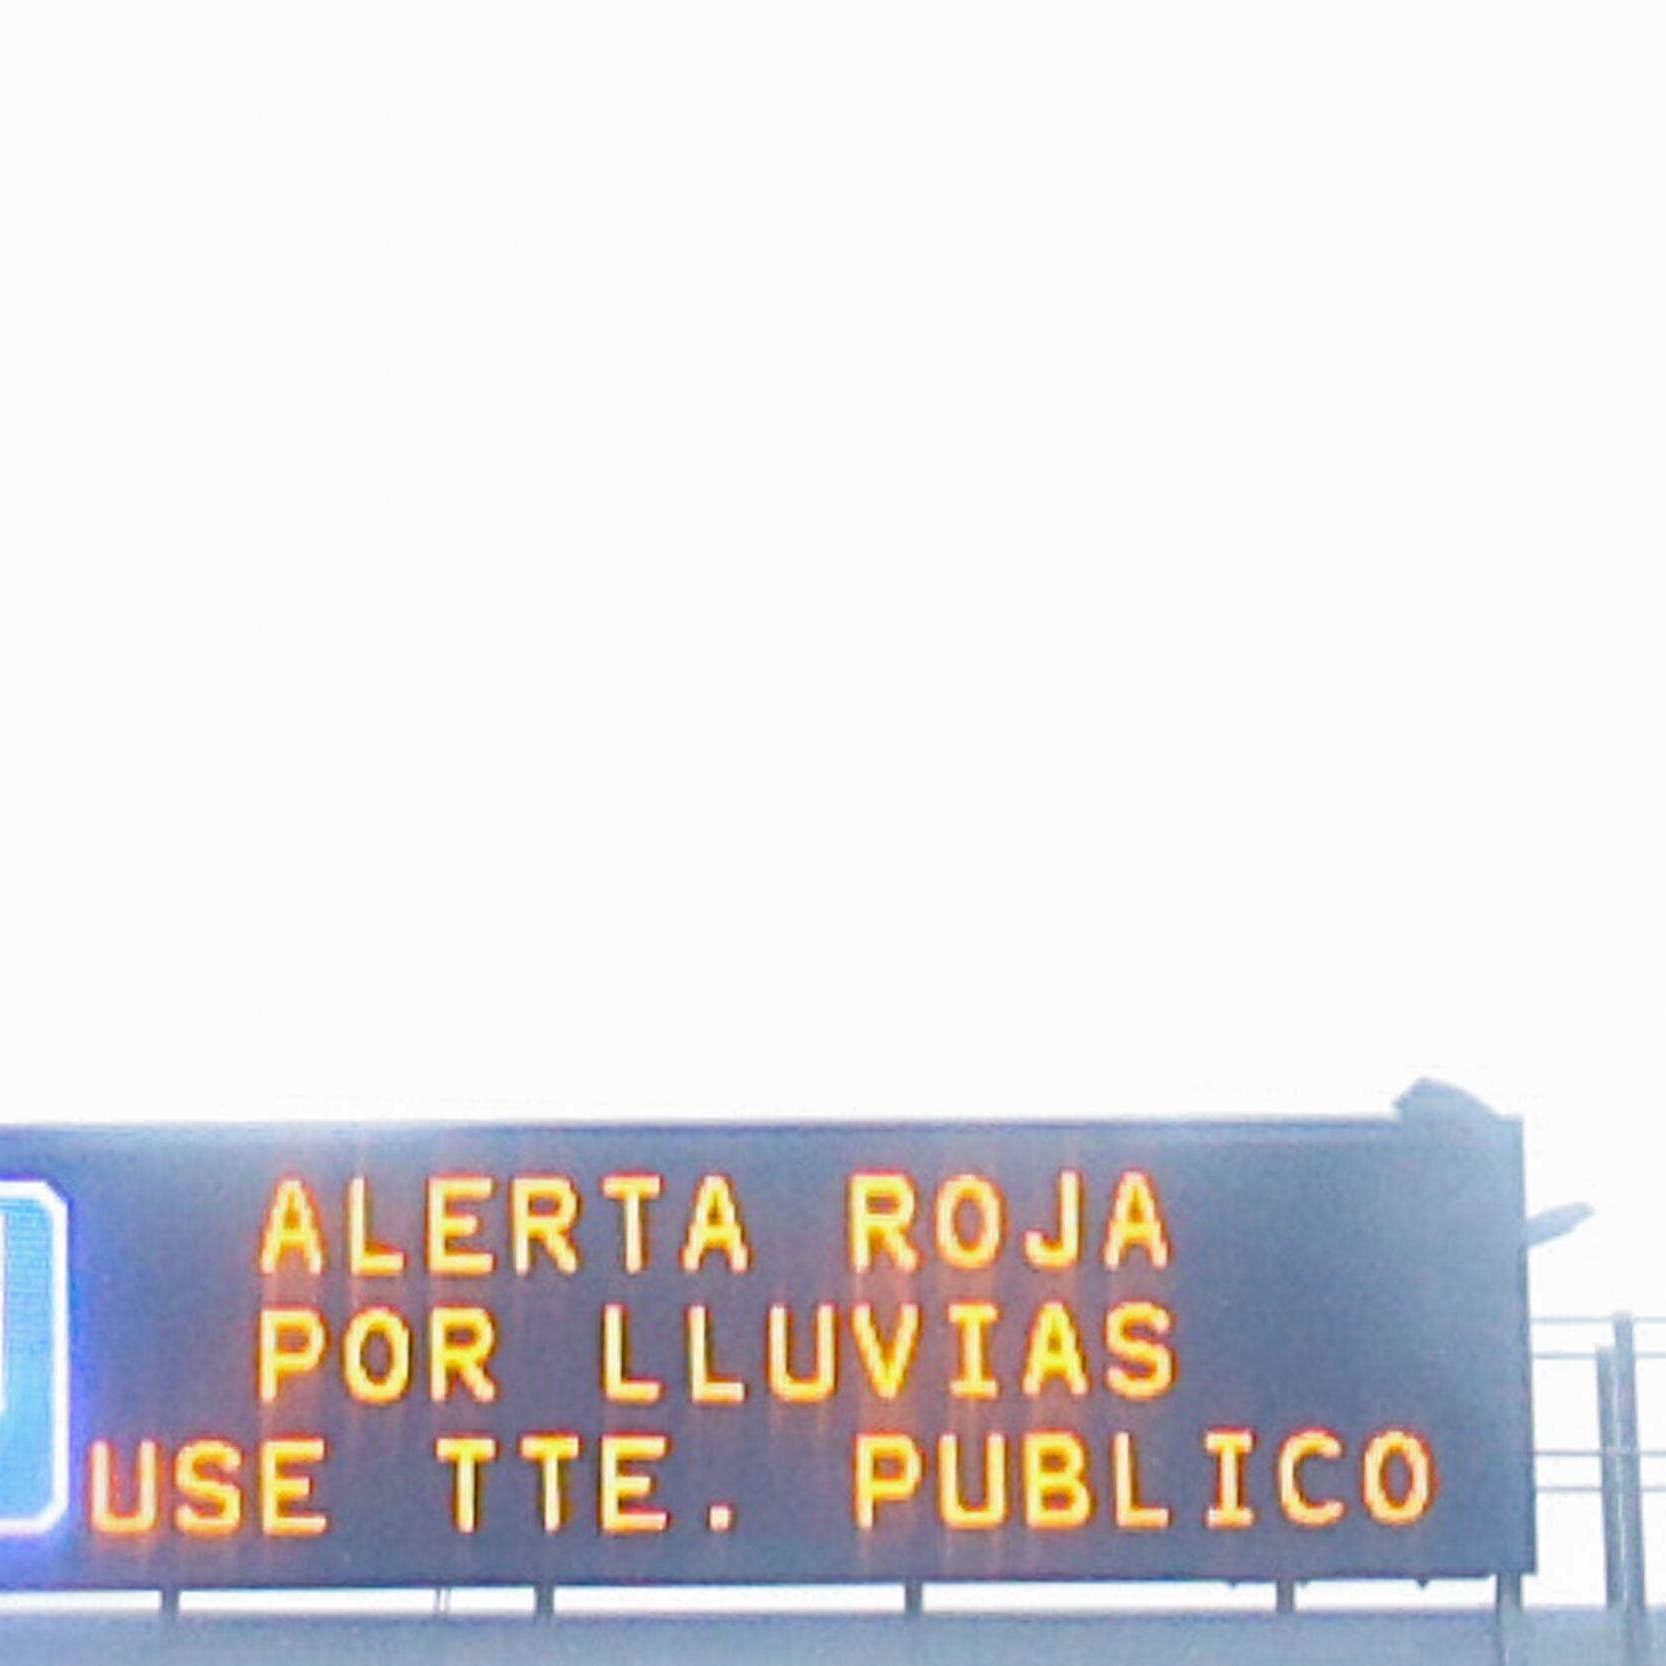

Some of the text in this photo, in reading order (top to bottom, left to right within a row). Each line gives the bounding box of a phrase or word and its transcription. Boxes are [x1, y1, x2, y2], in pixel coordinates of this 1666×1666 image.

[260, 1173, 1172, 1275] ALERTA ROJA
[256, 1302, 1178, 1403] POR LLUVIAS
[88, 1430, 1435, 1535] USE TTE. PUBLICO
